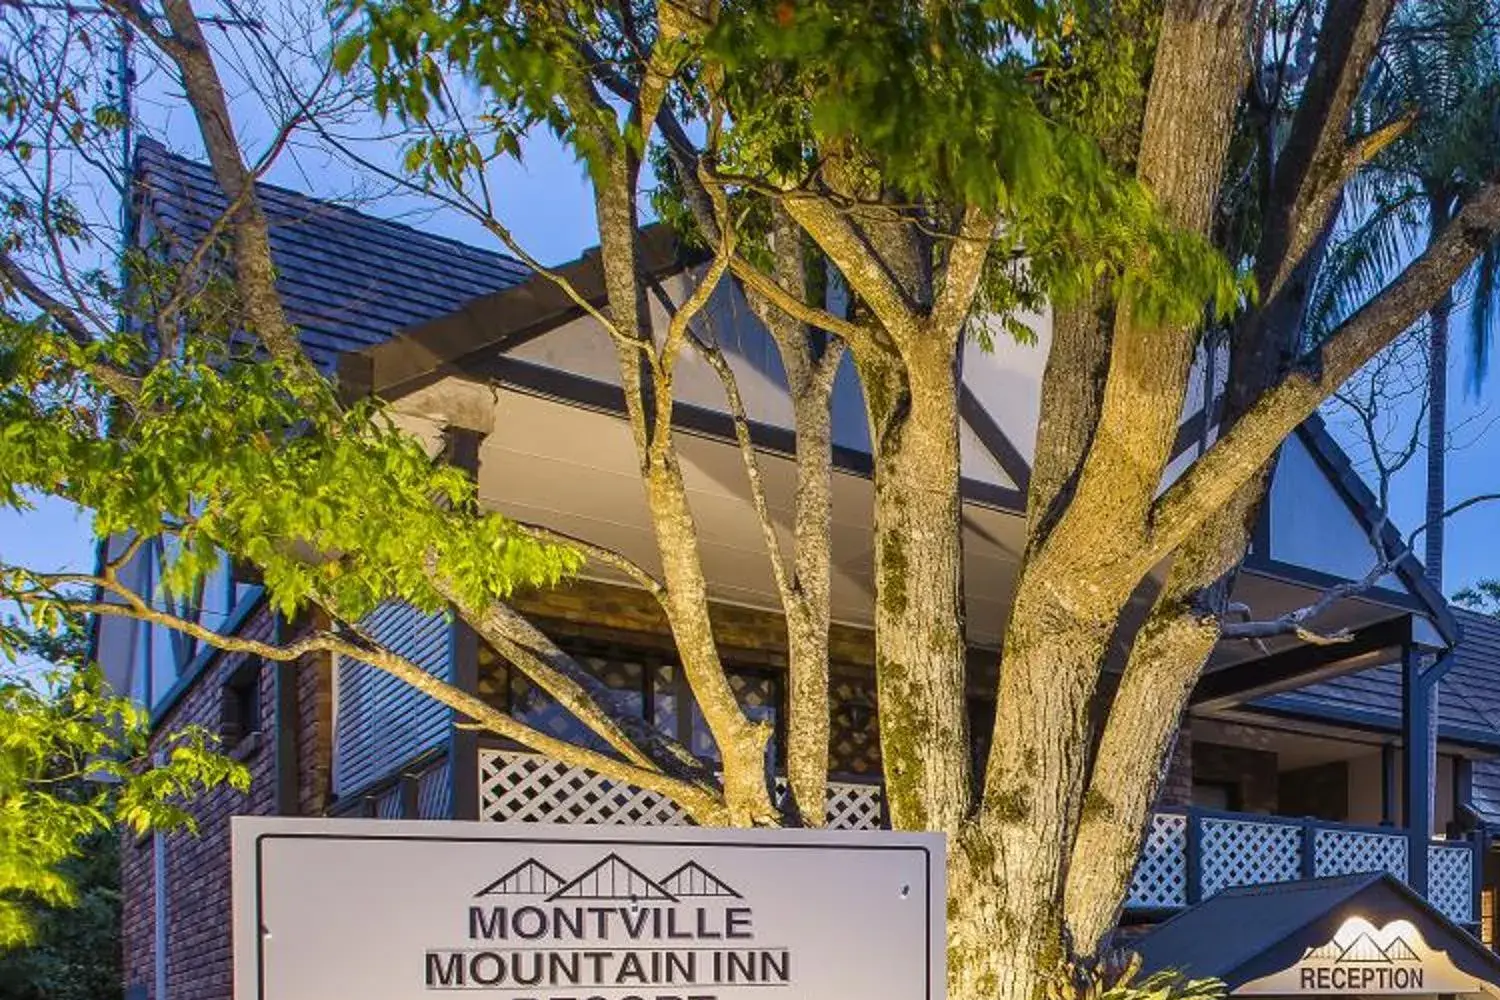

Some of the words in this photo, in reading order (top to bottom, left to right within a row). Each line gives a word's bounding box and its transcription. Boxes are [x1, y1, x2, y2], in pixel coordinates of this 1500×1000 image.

[468, 905, 753, 940] MONTVILLE
[425, 951, 699, 987] MOUNTAIN
[712, 948, 791, 984] INN
[1300, 967, 1424, 990] RECEPTION
